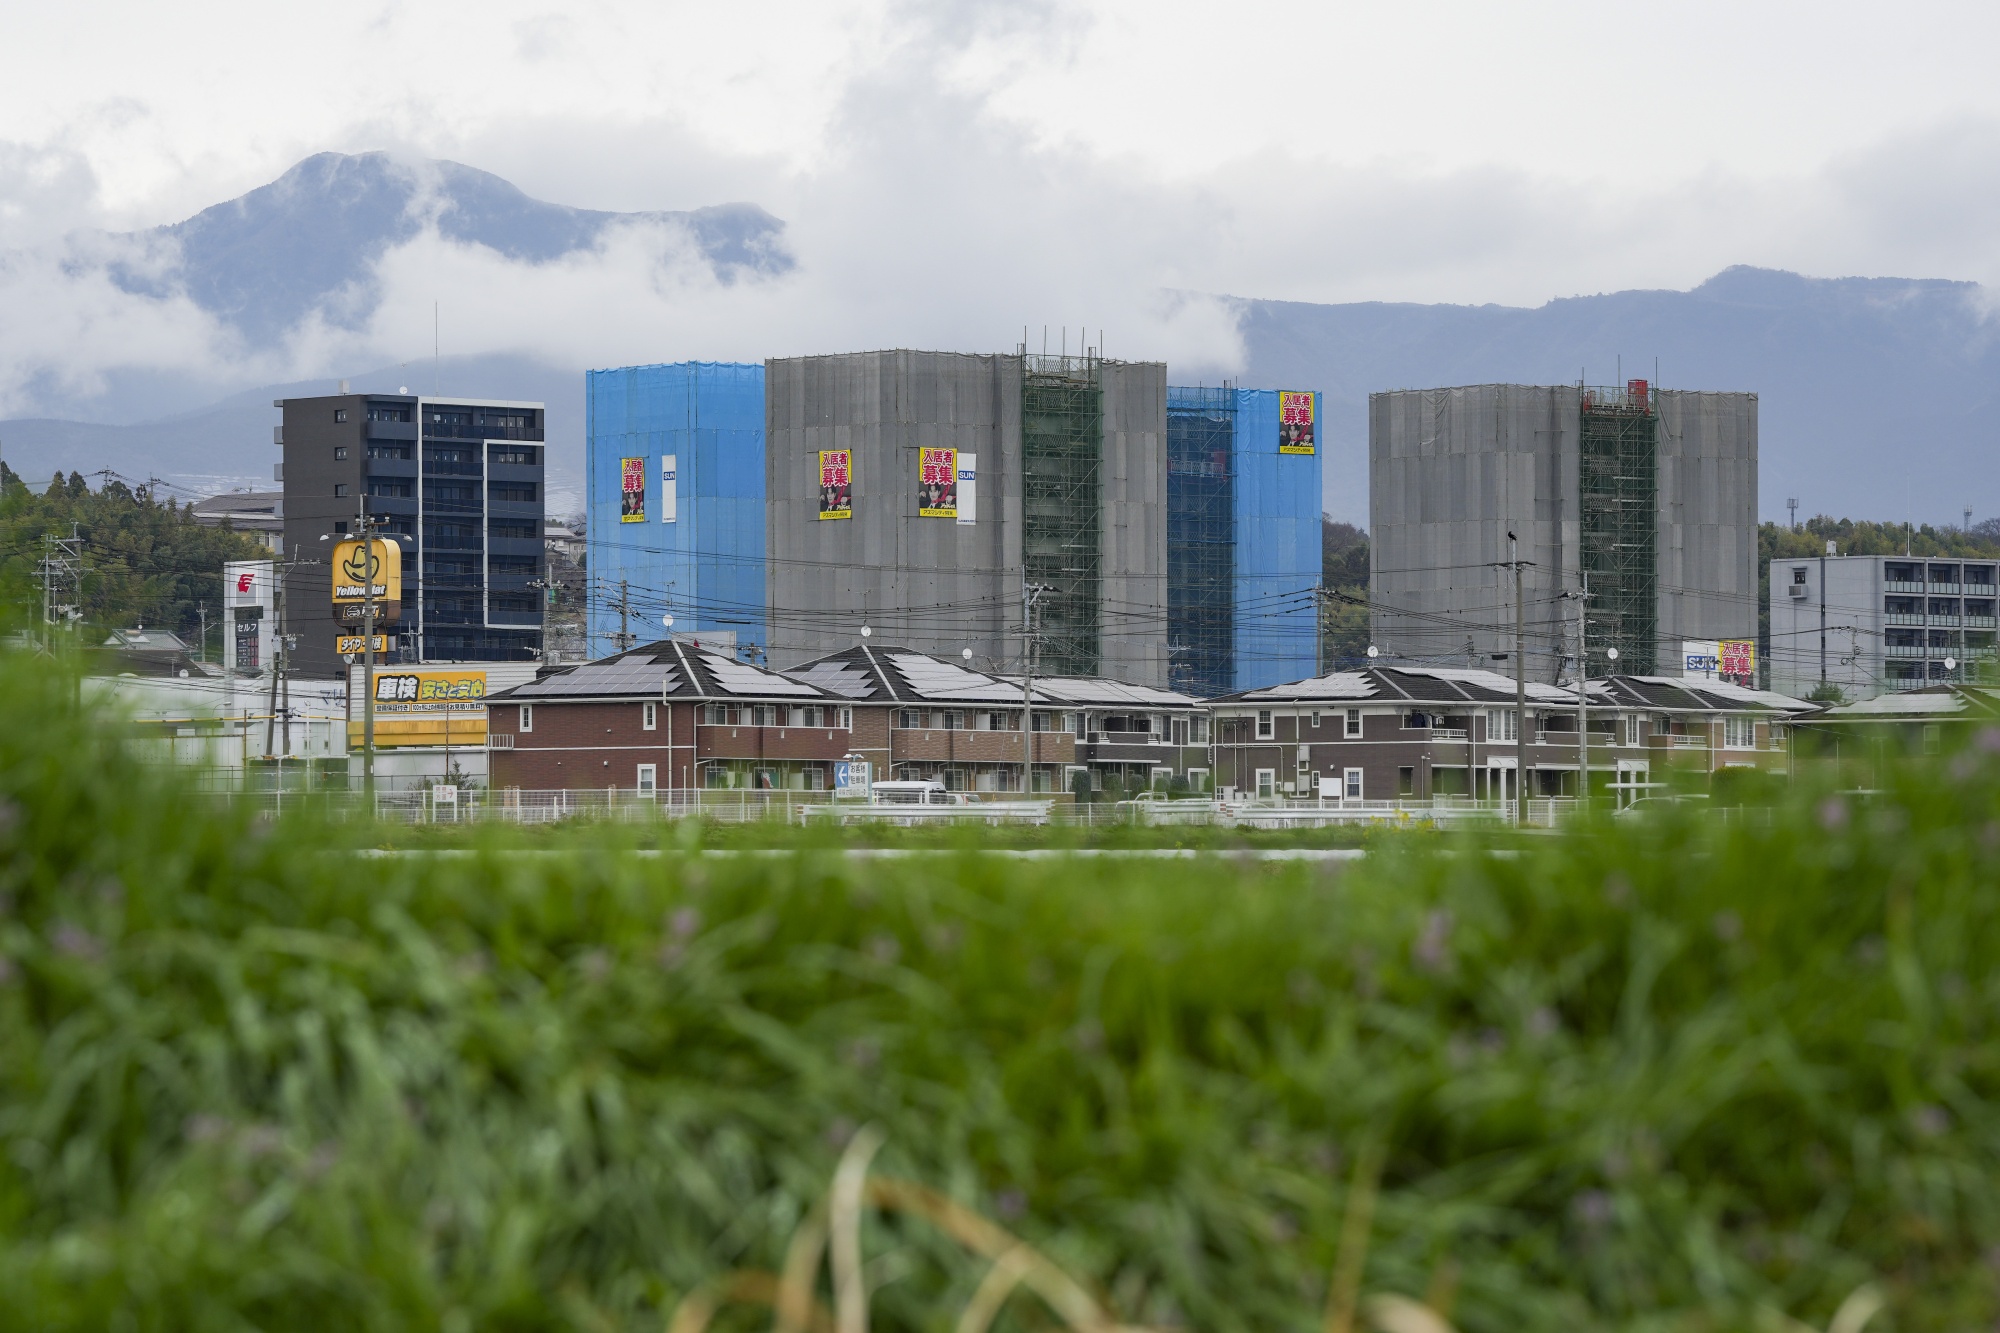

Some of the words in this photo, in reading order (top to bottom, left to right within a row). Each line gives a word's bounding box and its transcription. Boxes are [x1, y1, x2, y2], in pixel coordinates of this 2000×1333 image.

[1283, 394, 1311, 406] 入居者
[1283, 407, 1311, 425] 募集
[822, 452, 848, 467] 入居者
[923, 450, 953, 464] 入居者
[664, 472, 675, 480] SUN
[823, 467, 849, 487] 募集
[923, 464, 953, 485] 募集
[237, 623, 257, 632] セルフ
[341, 637, 382, 650] タイヤ・検
[1722, 643, 1751, 655] 入居者
[1688, 657, 1714, 668] SUN
[1722, 656, 1751, 675] 募集
[376, 676, 420, 701] 車検
[421, 679, 484, 699] 安さと安心
